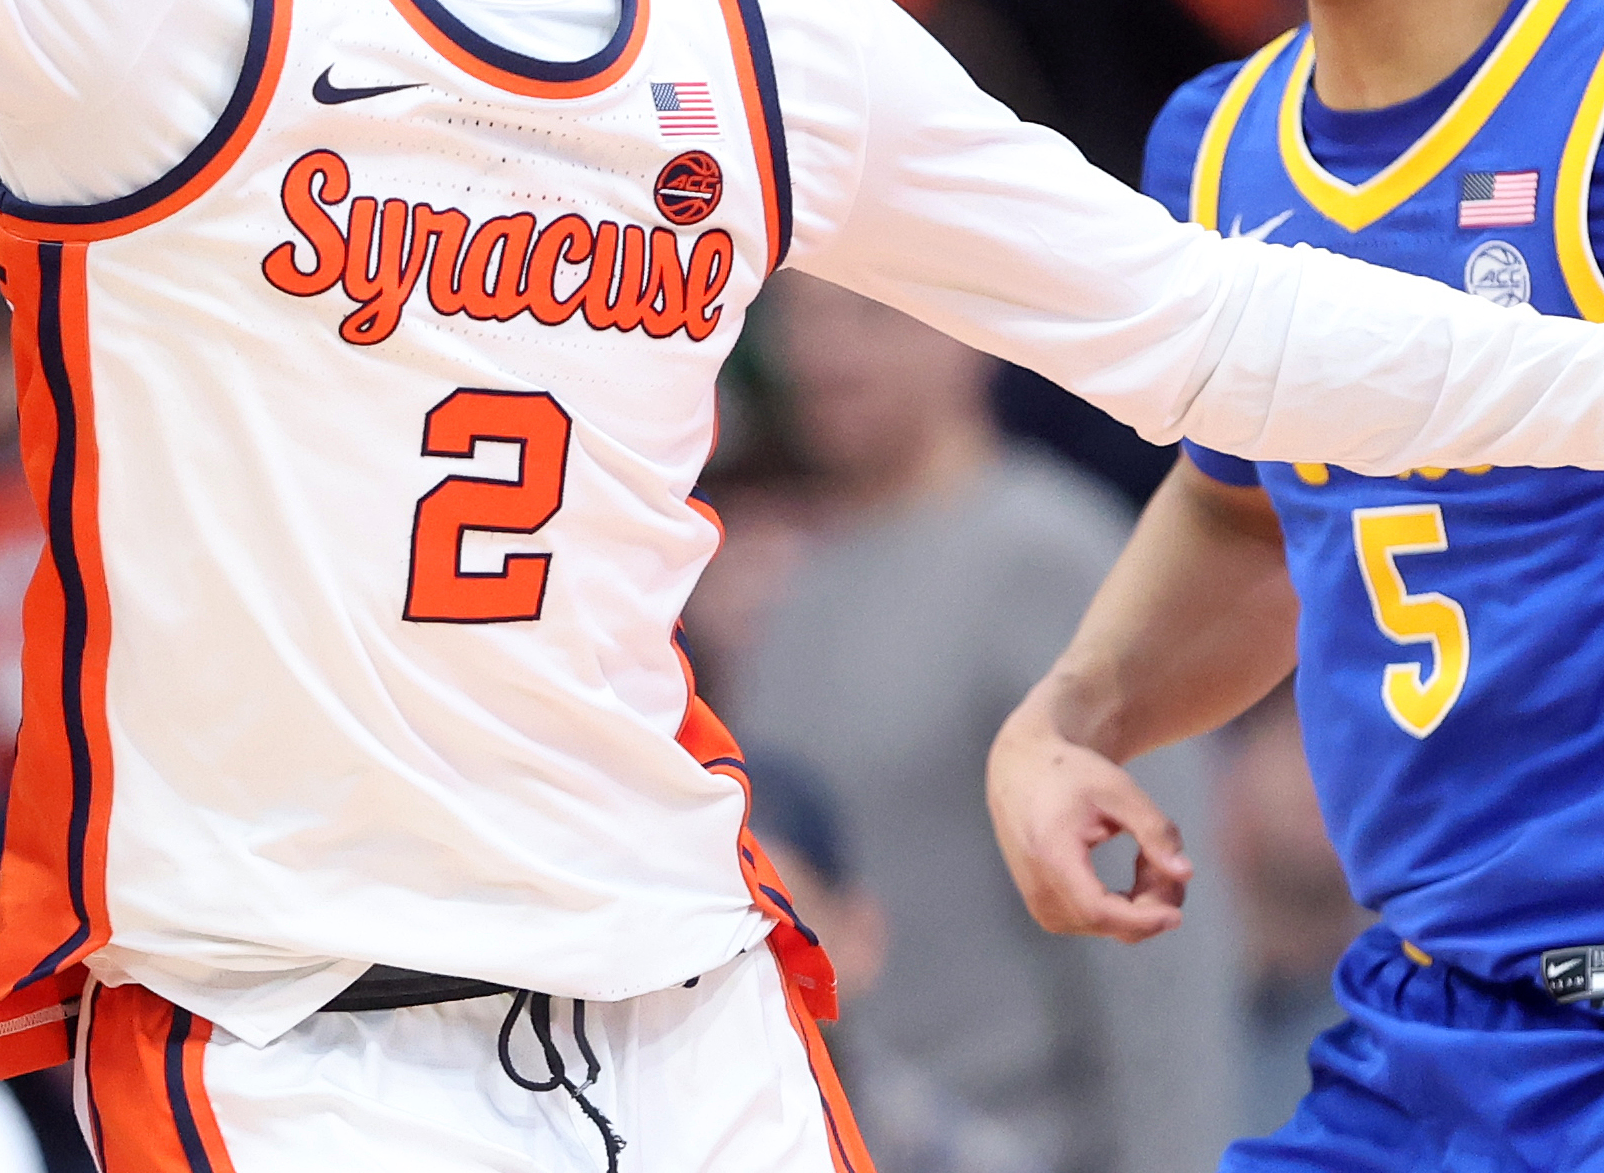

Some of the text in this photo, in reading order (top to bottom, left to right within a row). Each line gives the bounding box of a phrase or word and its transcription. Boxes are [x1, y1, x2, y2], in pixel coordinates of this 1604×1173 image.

[262, 148, 734, 346] Syracuse
[666, 173, 720, 194] ACC
[1479, 267, 1522, 284] ACC
[402, 387, 573, 624] 2
[1352, 503, 1470, 740] 5
